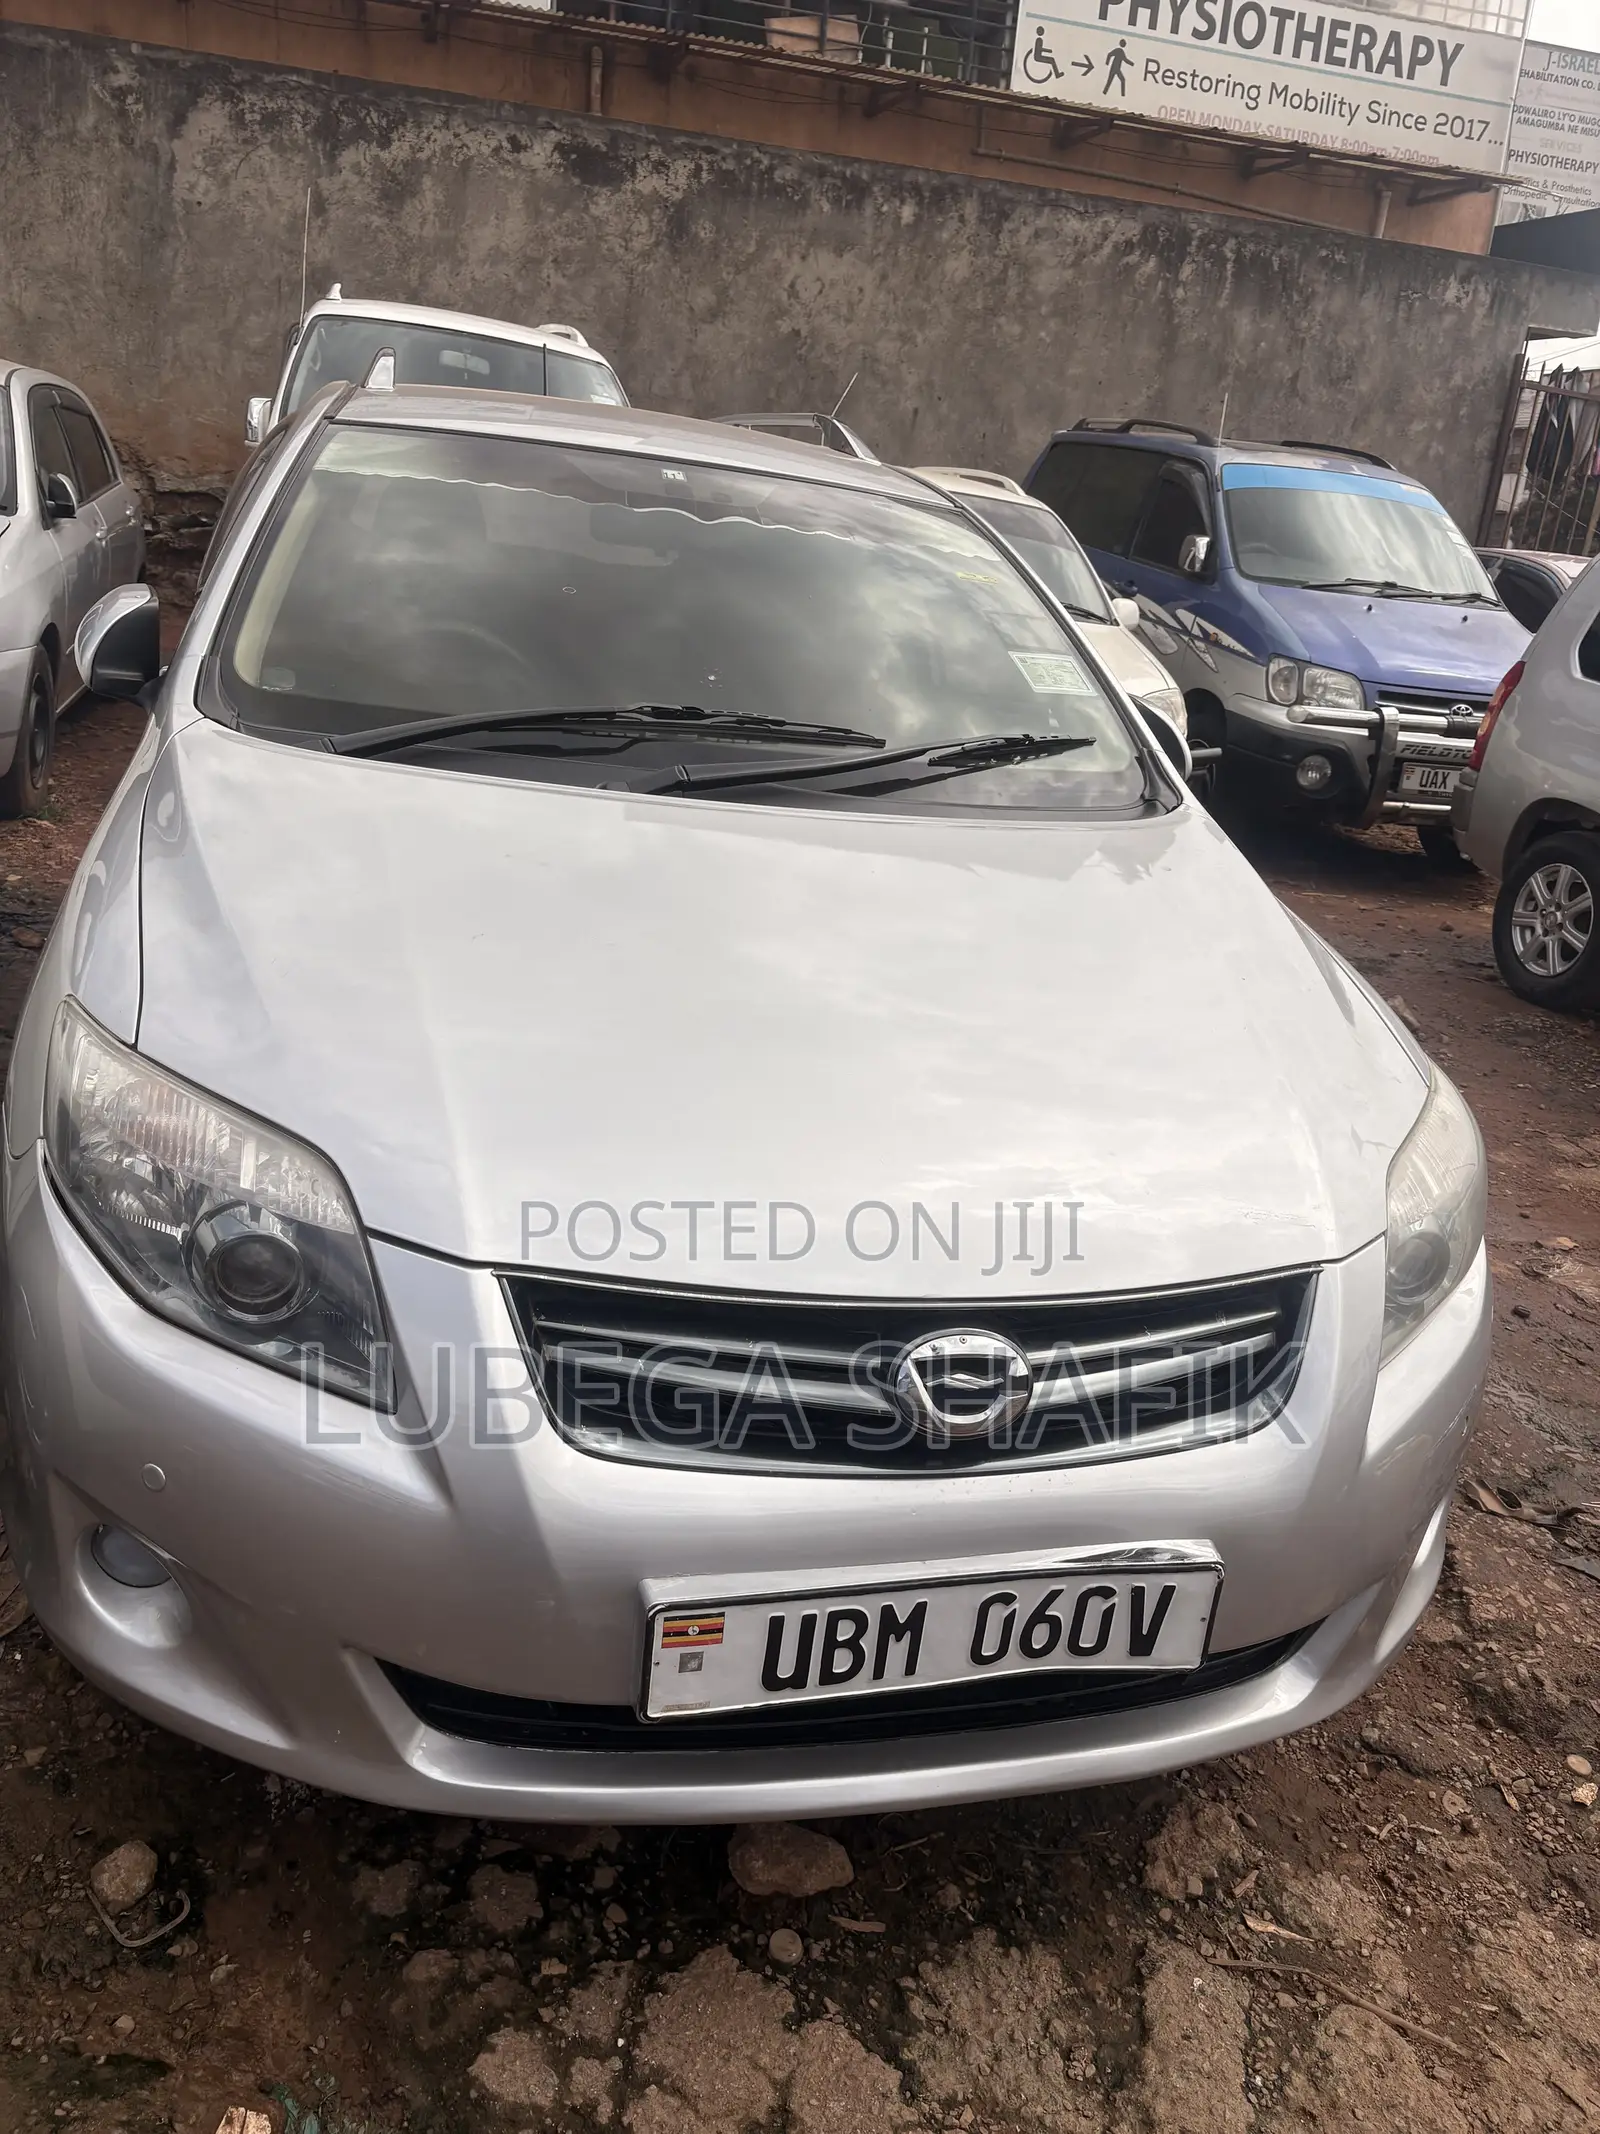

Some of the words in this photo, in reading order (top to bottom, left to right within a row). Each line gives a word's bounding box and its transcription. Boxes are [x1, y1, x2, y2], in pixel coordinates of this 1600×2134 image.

[1581, 79, 1596, 90] CO.
[1143, 57, 1262, 110] Restoring
[1268, 81, 1361, 126] Mobility
[1365, 100, 1428, 133] Since
[1157, 104, 1196, 122] OPEN
[1515, 116, 1566, 133] AMAGUMBA
[1508, 149, 1600, 174] PHYSIOTHERAPY
[1541, 179, 1549, 189] &
[1551, 180, 1592, 196] Prosthetics
[1419, 770, 1451, 789] UAX
[760, 1600, 929, 1692] UBM
[969, 1583, 1177, 1666] 060V
